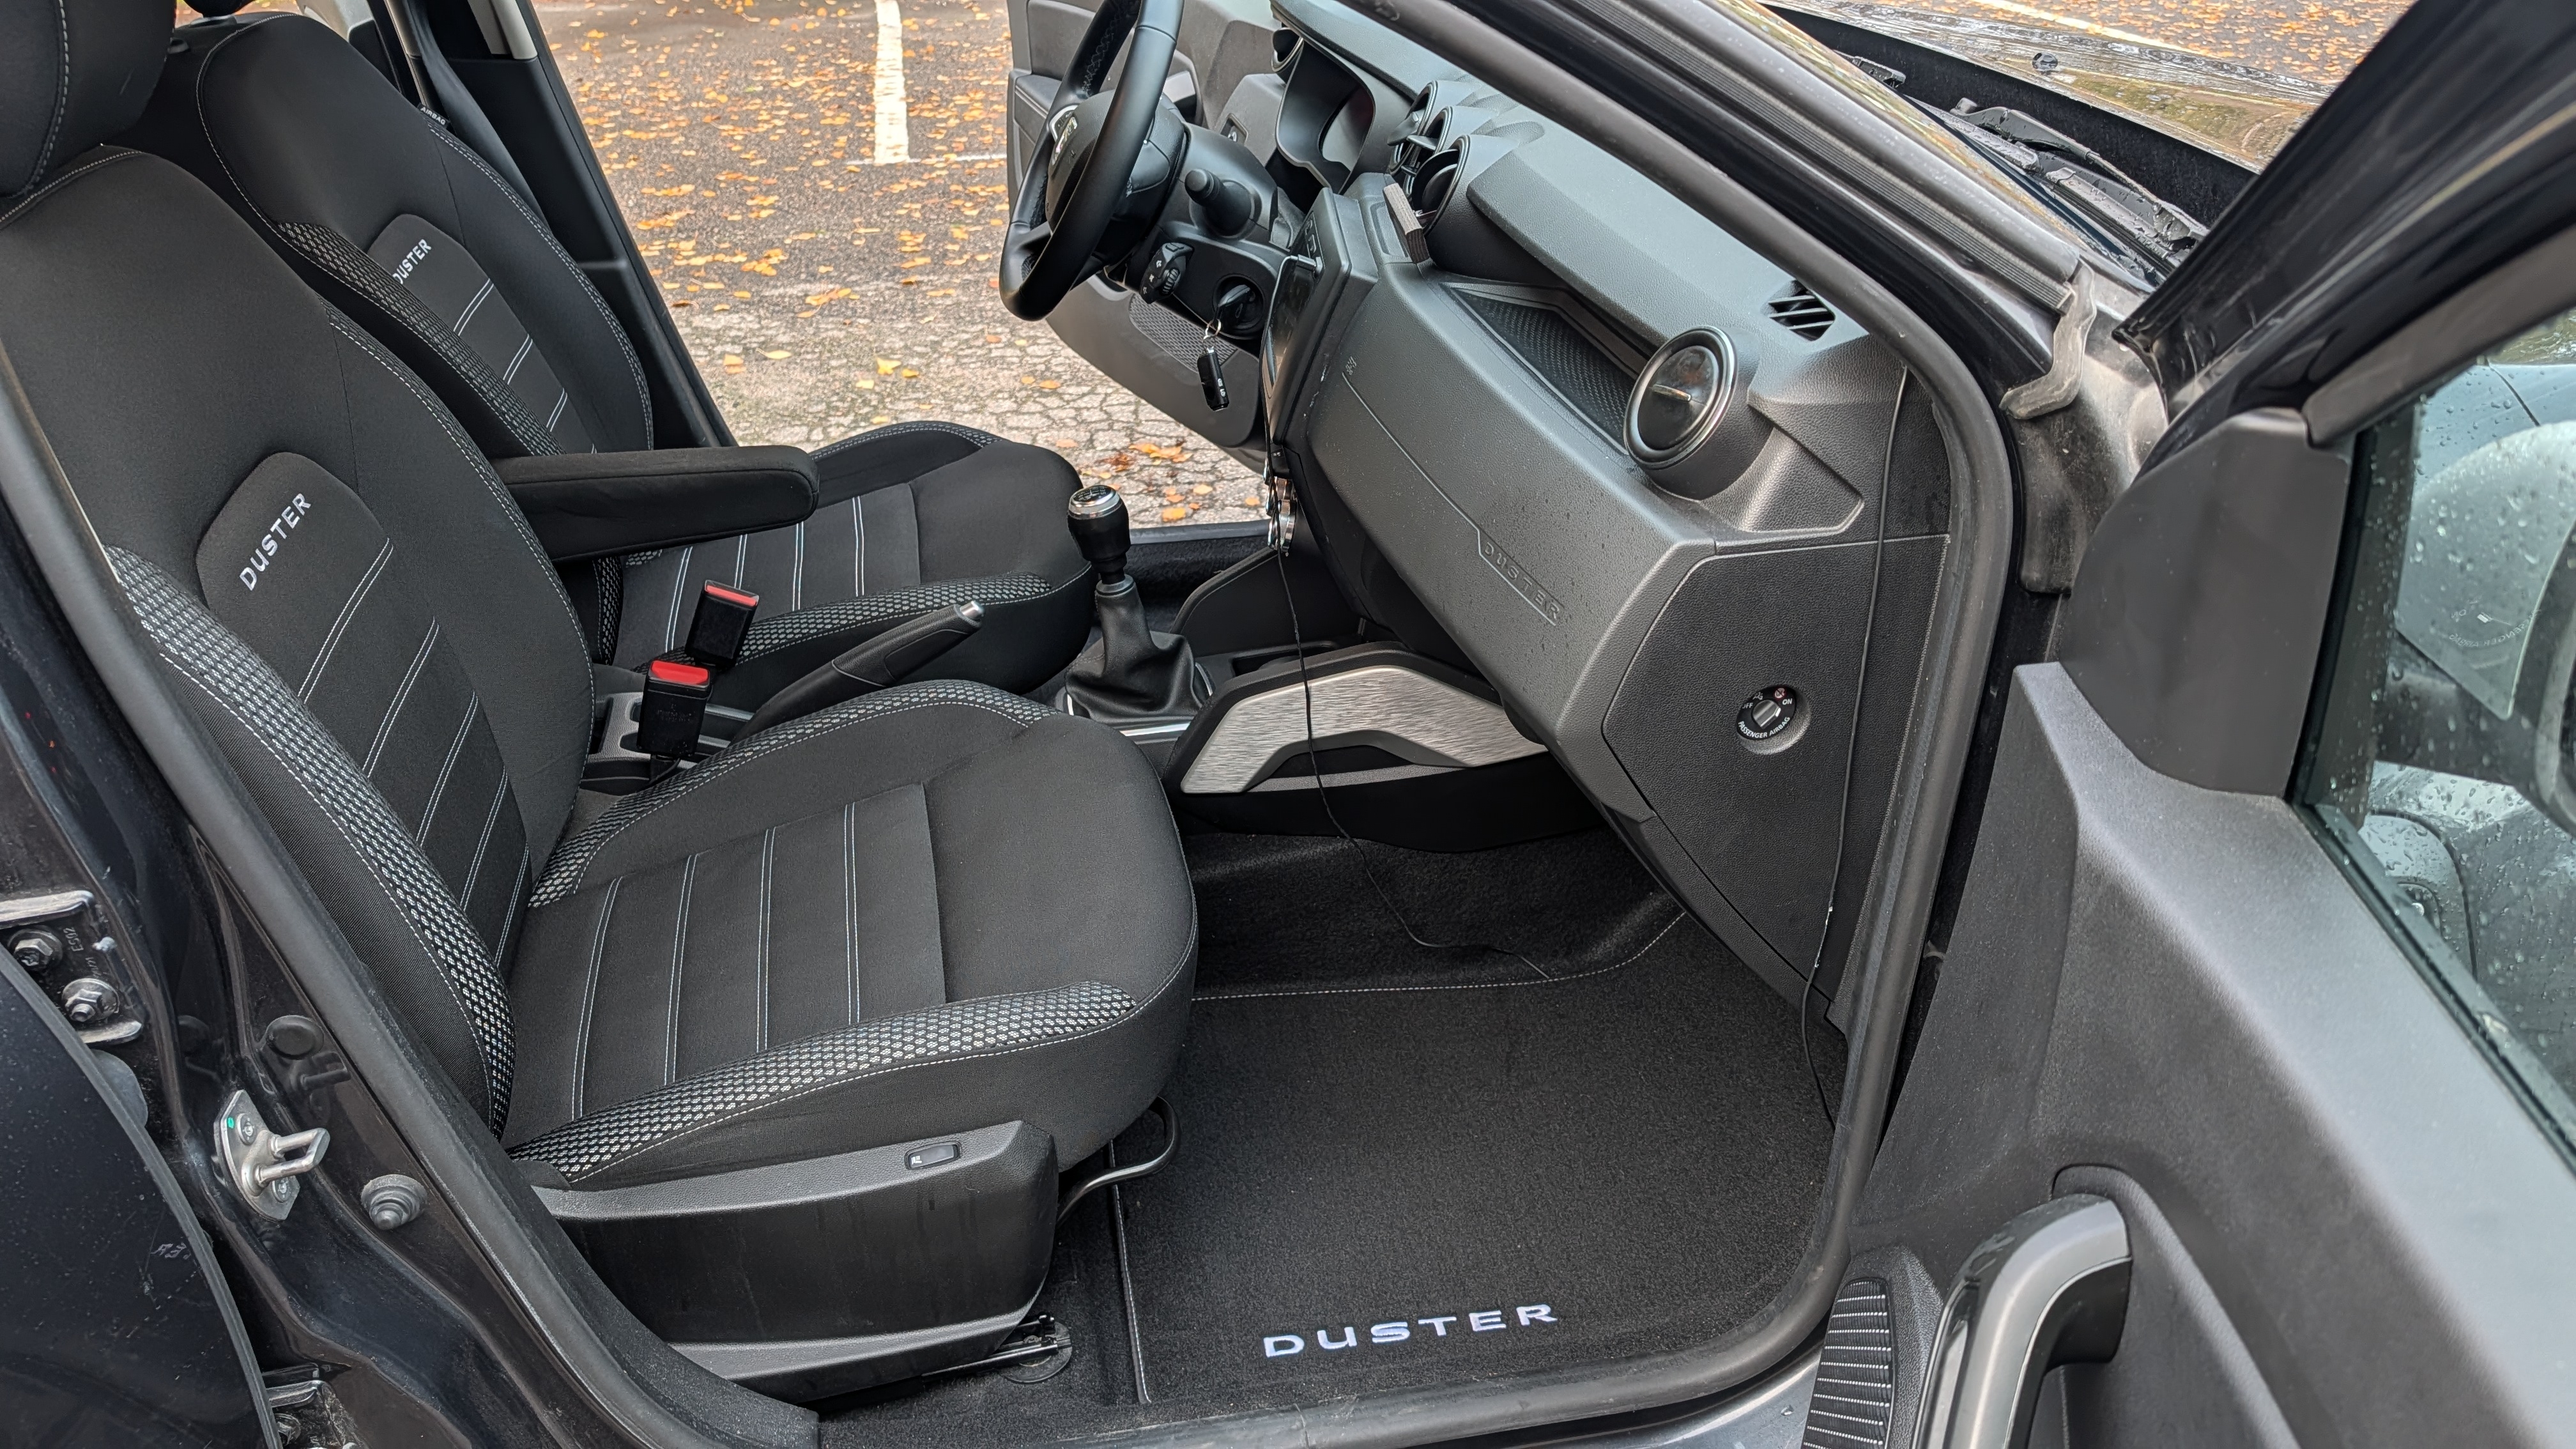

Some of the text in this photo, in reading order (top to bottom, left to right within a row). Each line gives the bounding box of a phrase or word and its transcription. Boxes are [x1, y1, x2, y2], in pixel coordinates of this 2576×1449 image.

[420, 106, 446, 125] AIRBAG
[240, 493, 311, 591] DUSTER
[1484, 542, 1560, 620] DUSTER
[1738, 716, 1790, 739] PASSENGER AIRBAG
[1263, 1303, 1558, 1358] DUSTER
